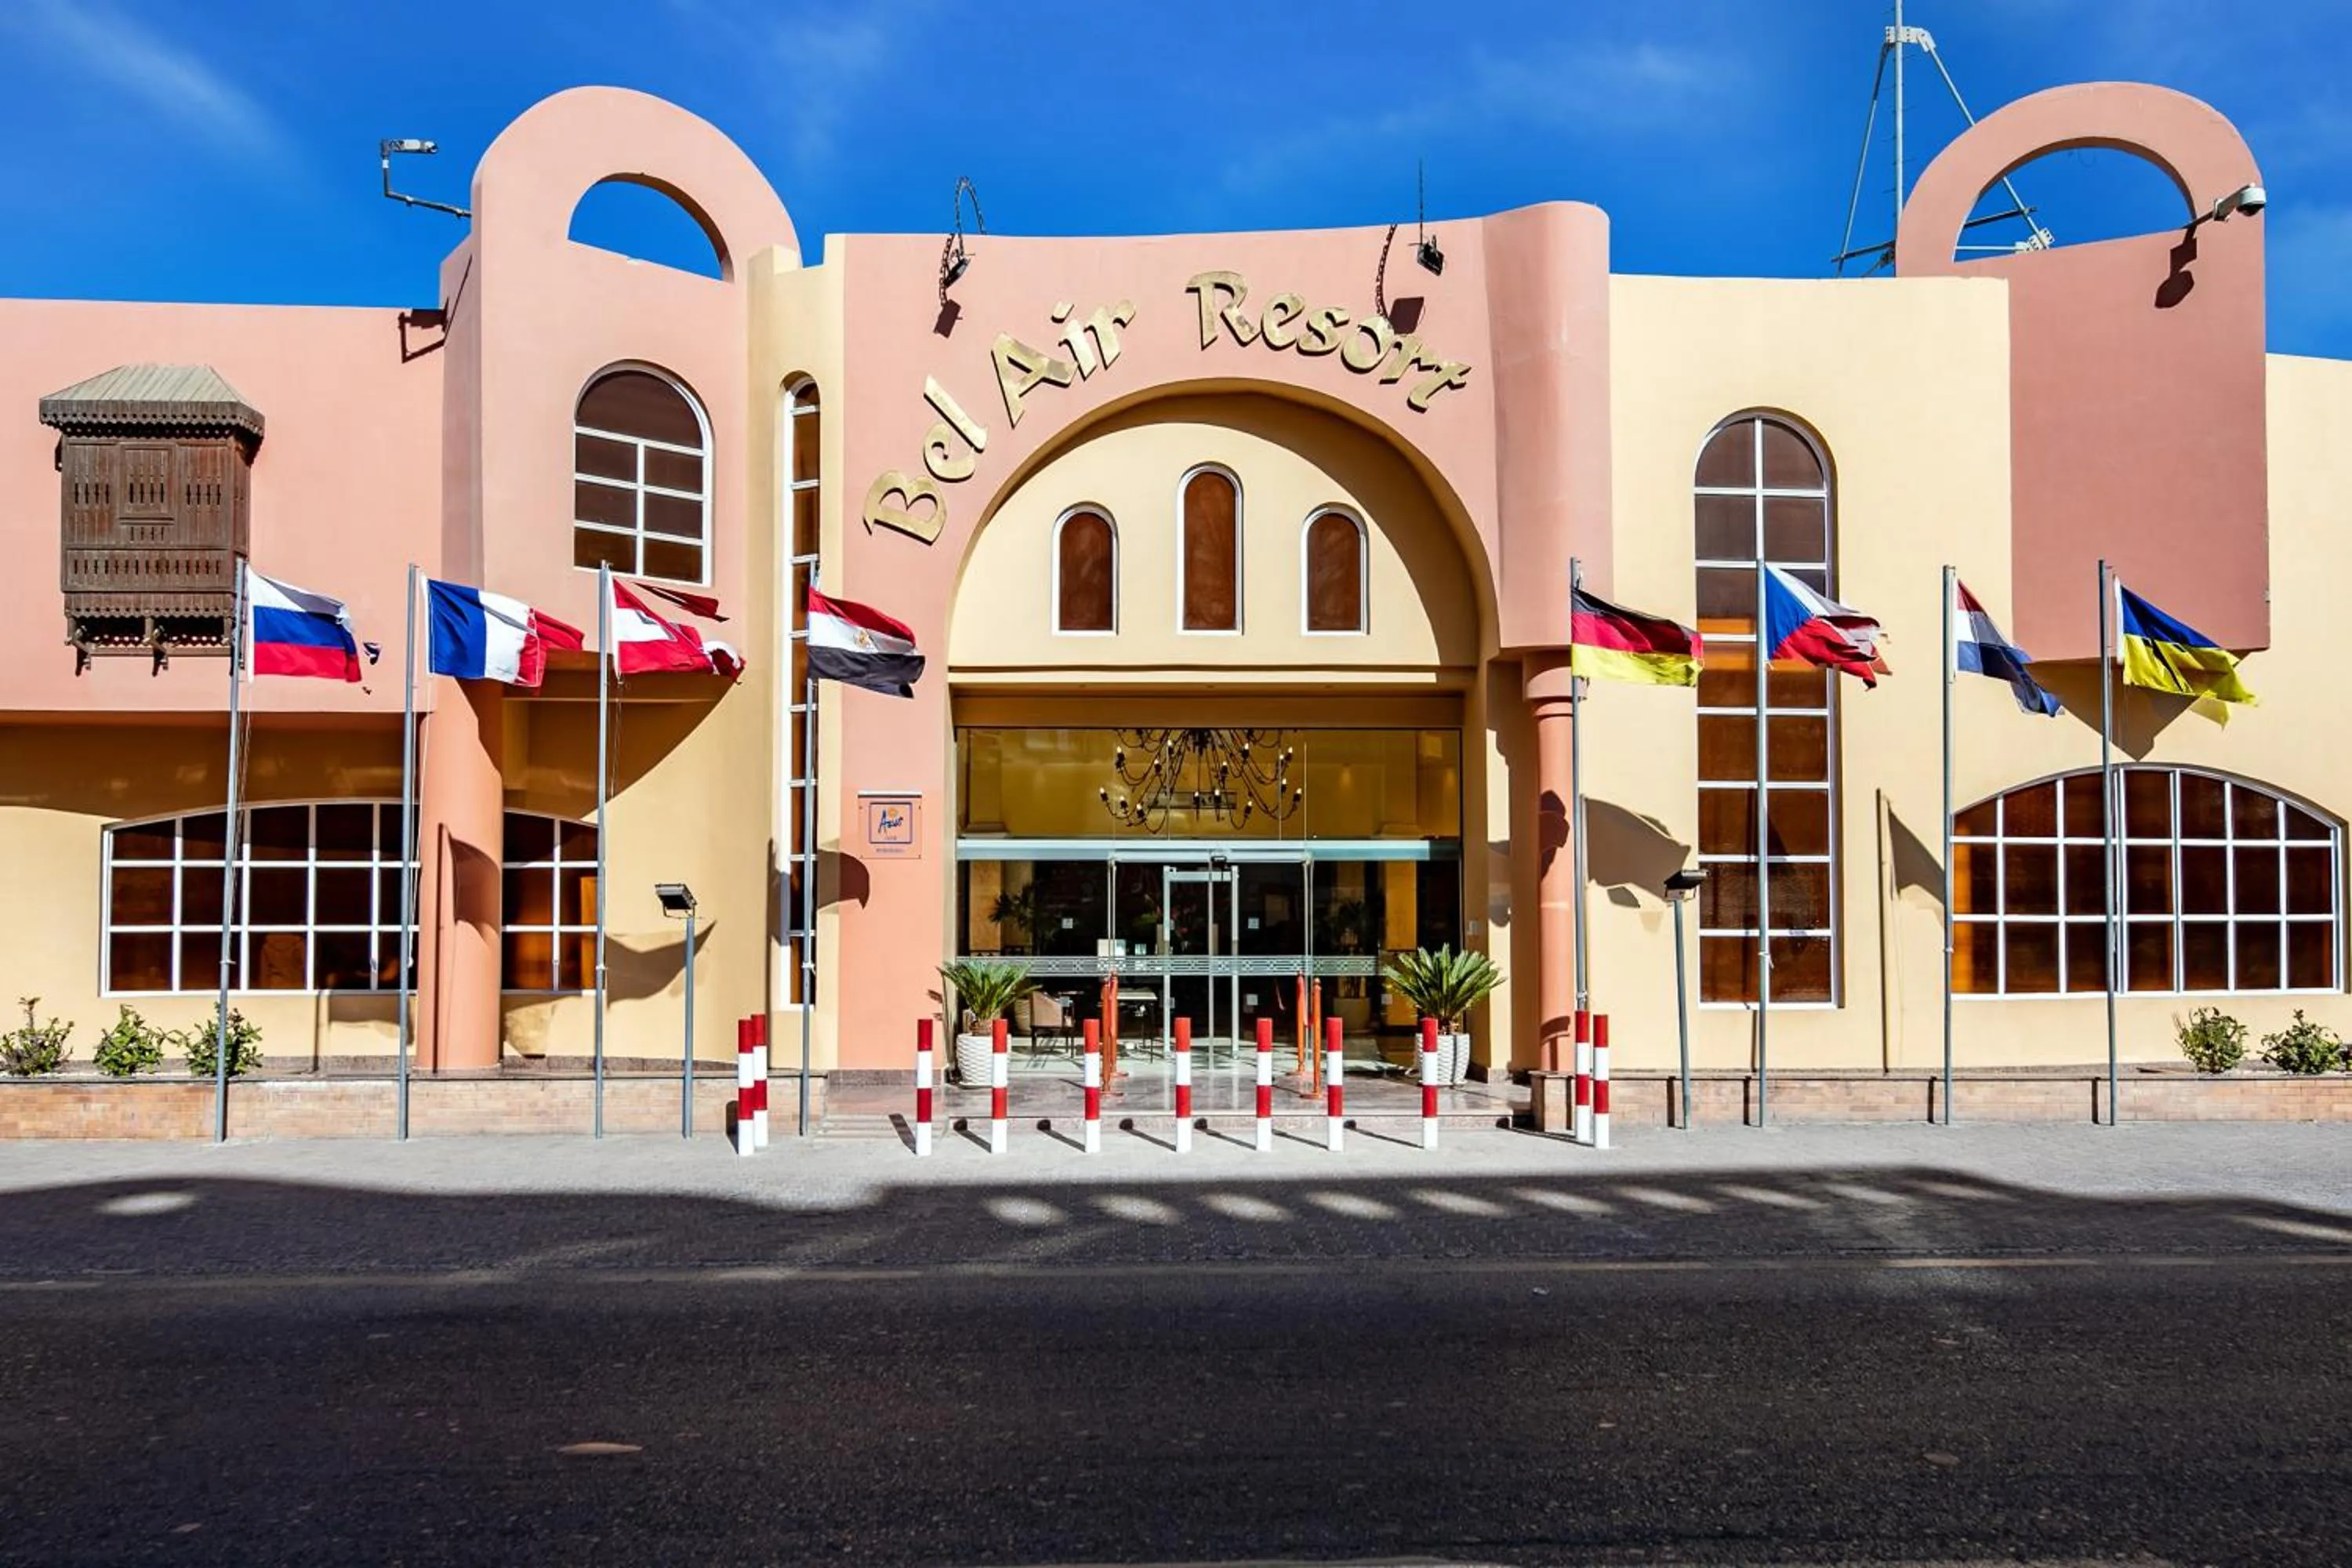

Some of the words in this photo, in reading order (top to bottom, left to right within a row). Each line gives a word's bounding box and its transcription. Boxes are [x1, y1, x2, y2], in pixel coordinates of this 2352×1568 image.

[862, 375, 988, 546] Bel
[990, 299, 1136, 430] Air
[1185, 270, 1472, 413] Resort
